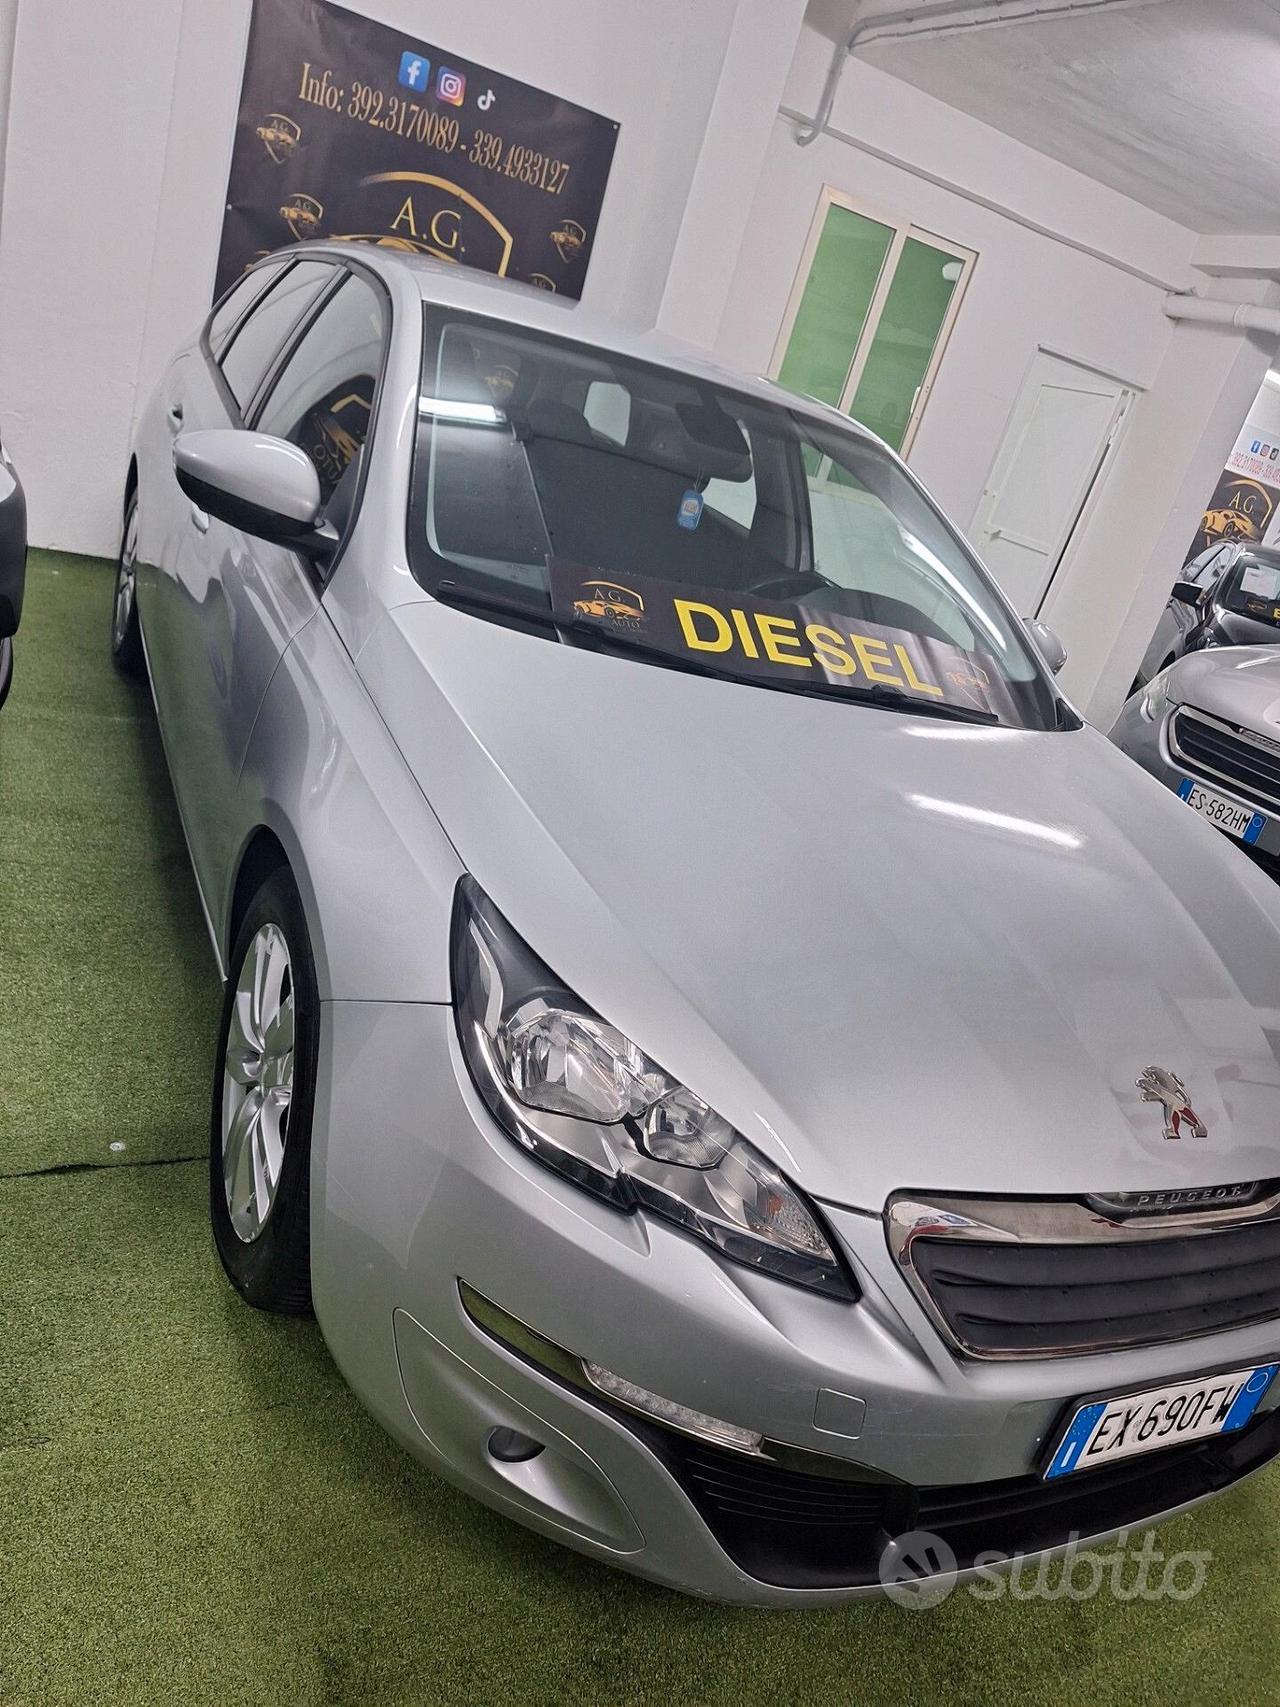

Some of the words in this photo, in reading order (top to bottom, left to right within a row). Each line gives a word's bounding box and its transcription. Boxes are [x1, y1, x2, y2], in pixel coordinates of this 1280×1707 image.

[298, 62, 344, 113] Info:
[347, 81, 460, 153] 392.3170089
[468, 129, 570, 195] 339.4933127
[389, 196, 466, 253] A.G.
[673, 598, 944, 697] DIESEL
[1137, 1185, 1241, 1206] PEUGEOT
